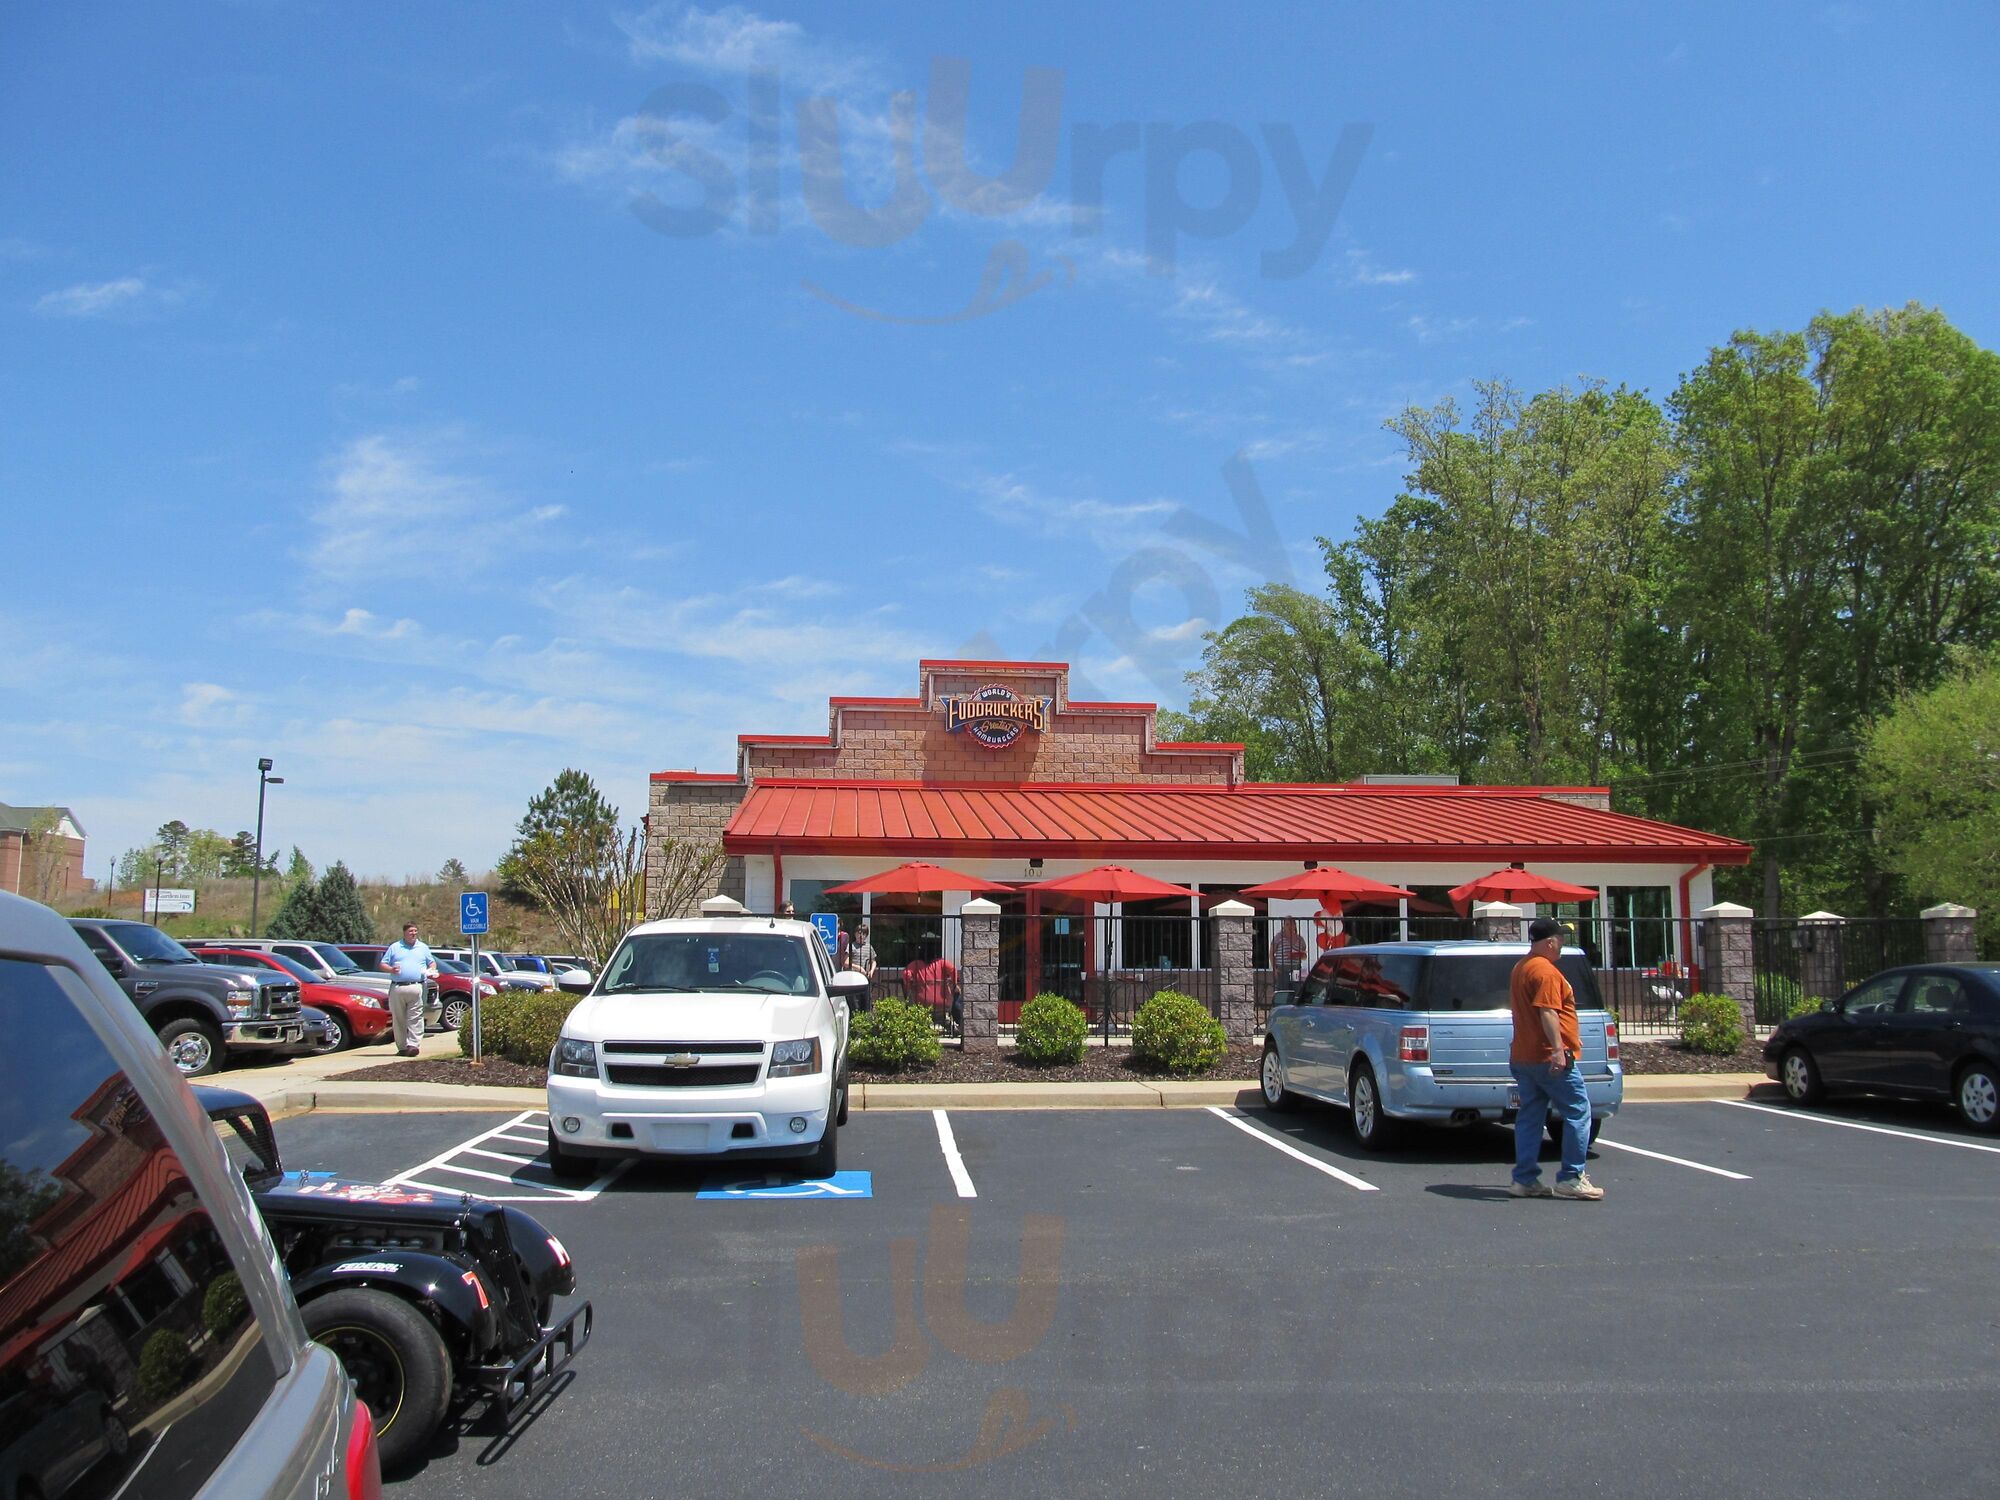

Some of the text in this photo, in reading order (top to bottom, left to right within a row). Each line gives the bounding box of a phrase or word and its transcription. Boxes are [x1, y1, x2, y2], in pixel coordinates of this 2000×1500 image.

[949, 699, 1043, 730] FUDDRUCKERS
[972, 726, 1019, 743] HAMBURGERS
[461, 1270, 489, 1310] 7
